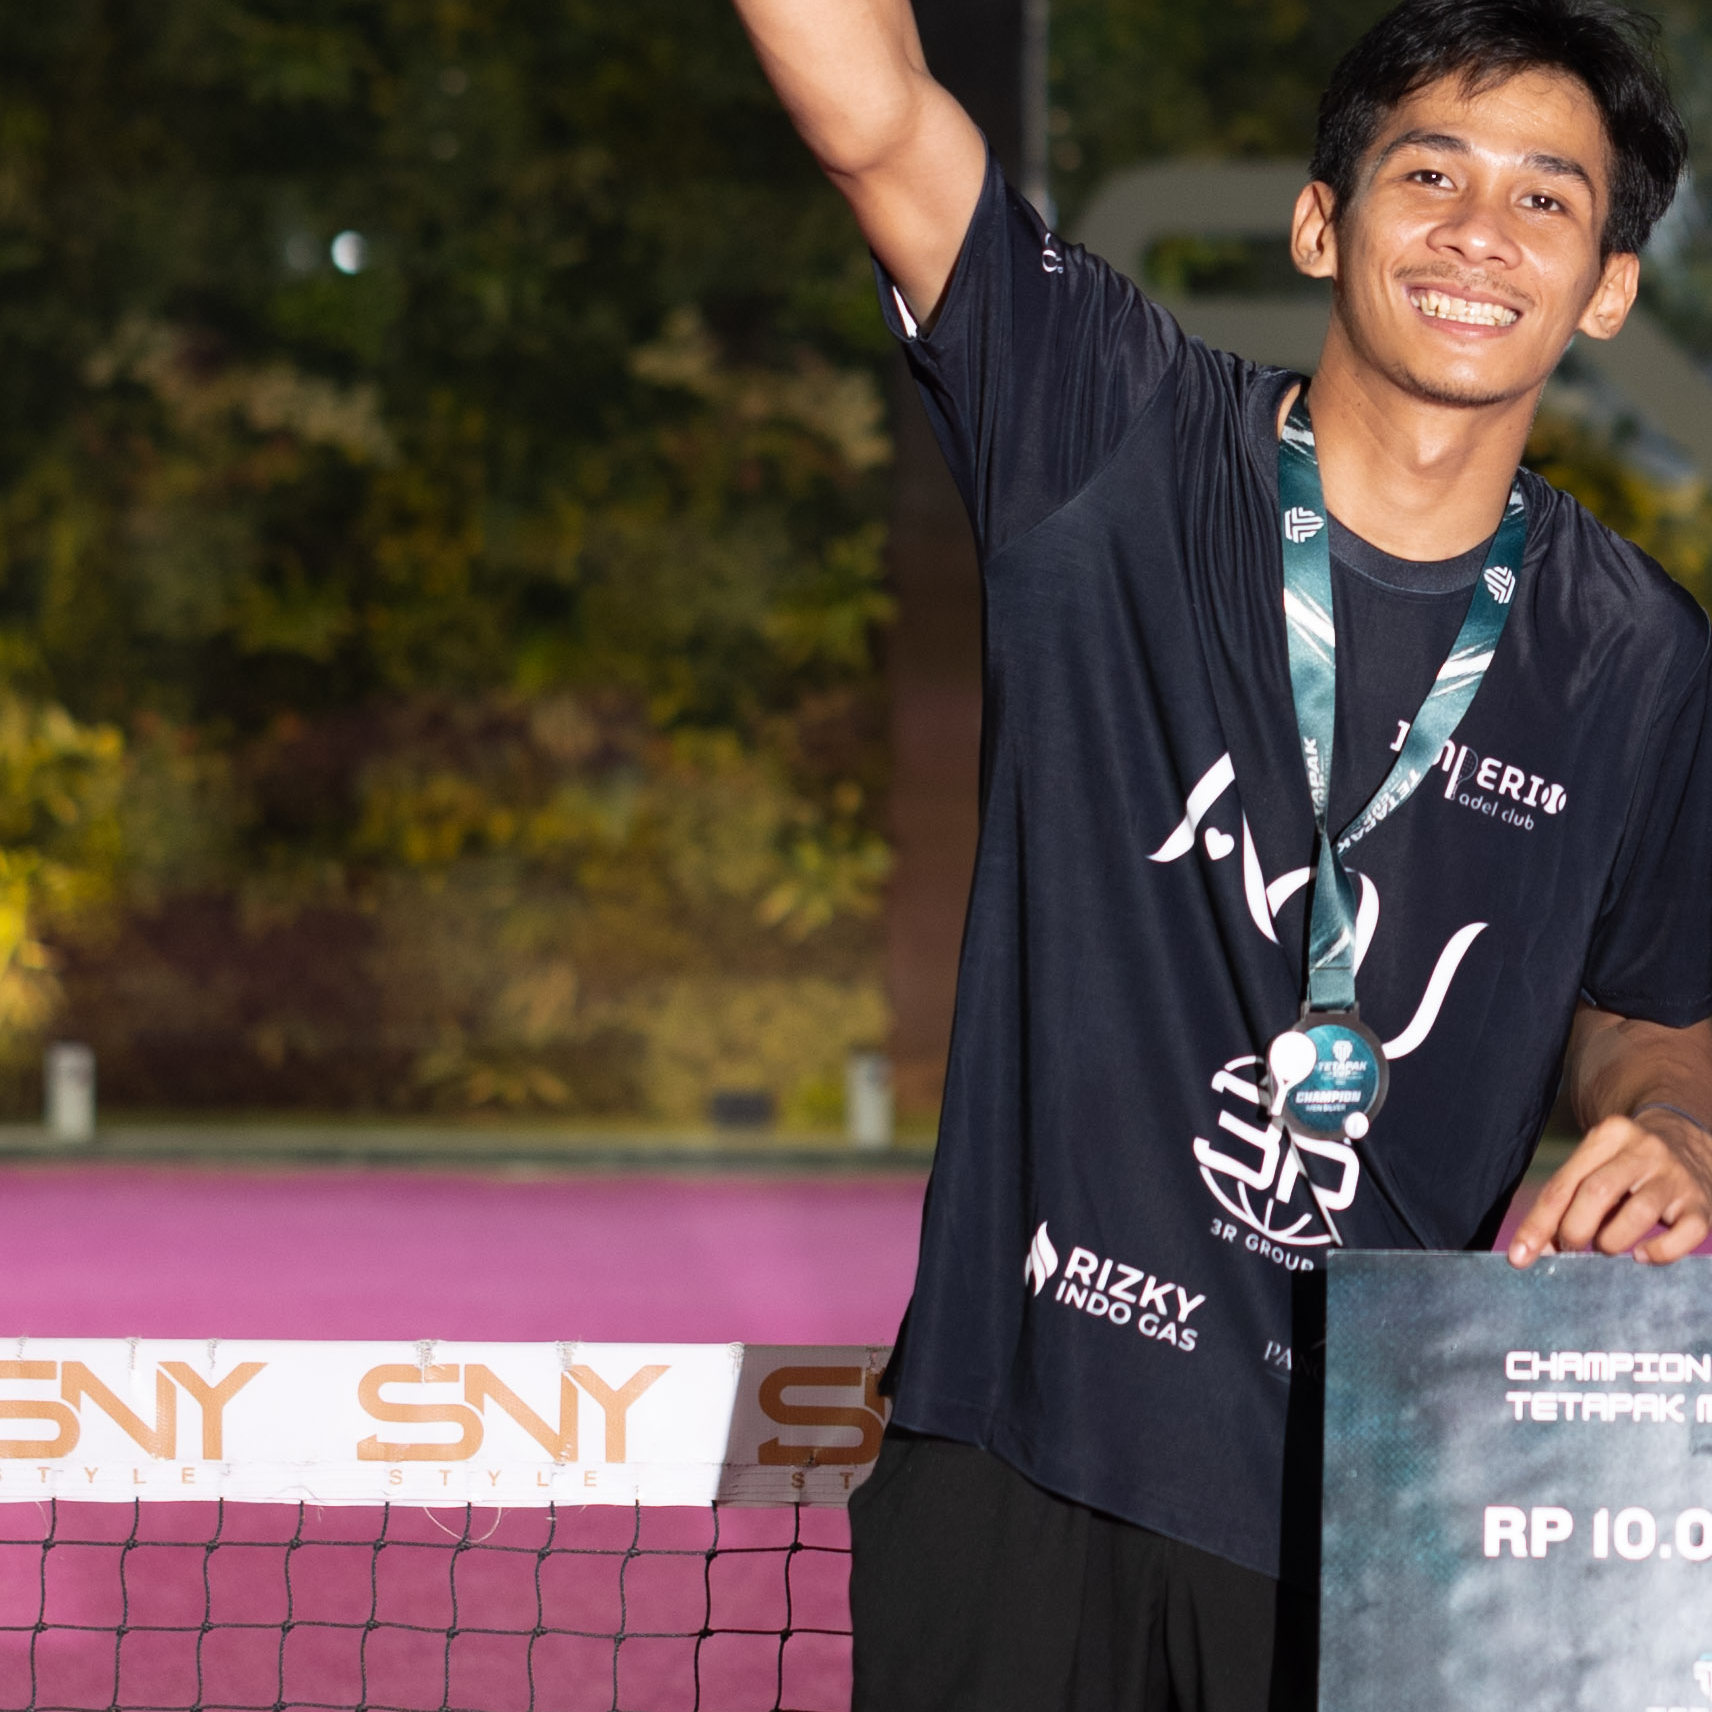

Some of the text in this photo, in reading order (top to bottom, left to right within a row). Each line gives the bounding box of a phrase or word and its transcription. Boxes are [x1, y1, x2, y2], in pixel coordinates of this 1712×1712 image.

[1459, 792, 1534, 831] adel club
[1295, 1090, 1361, 1103] CHAMPION
[1210, 1218, 1314, 1273] 3R GROUP
[1064, 1246, 1206, 1323] RIZKY
[1055, 1280, 1199, 1352] INDO GAS
[1505, 1351, 1711, 1383] CHAMPION
[357, 1364, 672, 1463] SNY
[1505, 1391, 1685, 1422] TETAPAK
[0, 1467, 196, 1484] TYLE
[389, 1469, 598, 1487] STYLE
[1483, 1506, 1573, 1558] RP
